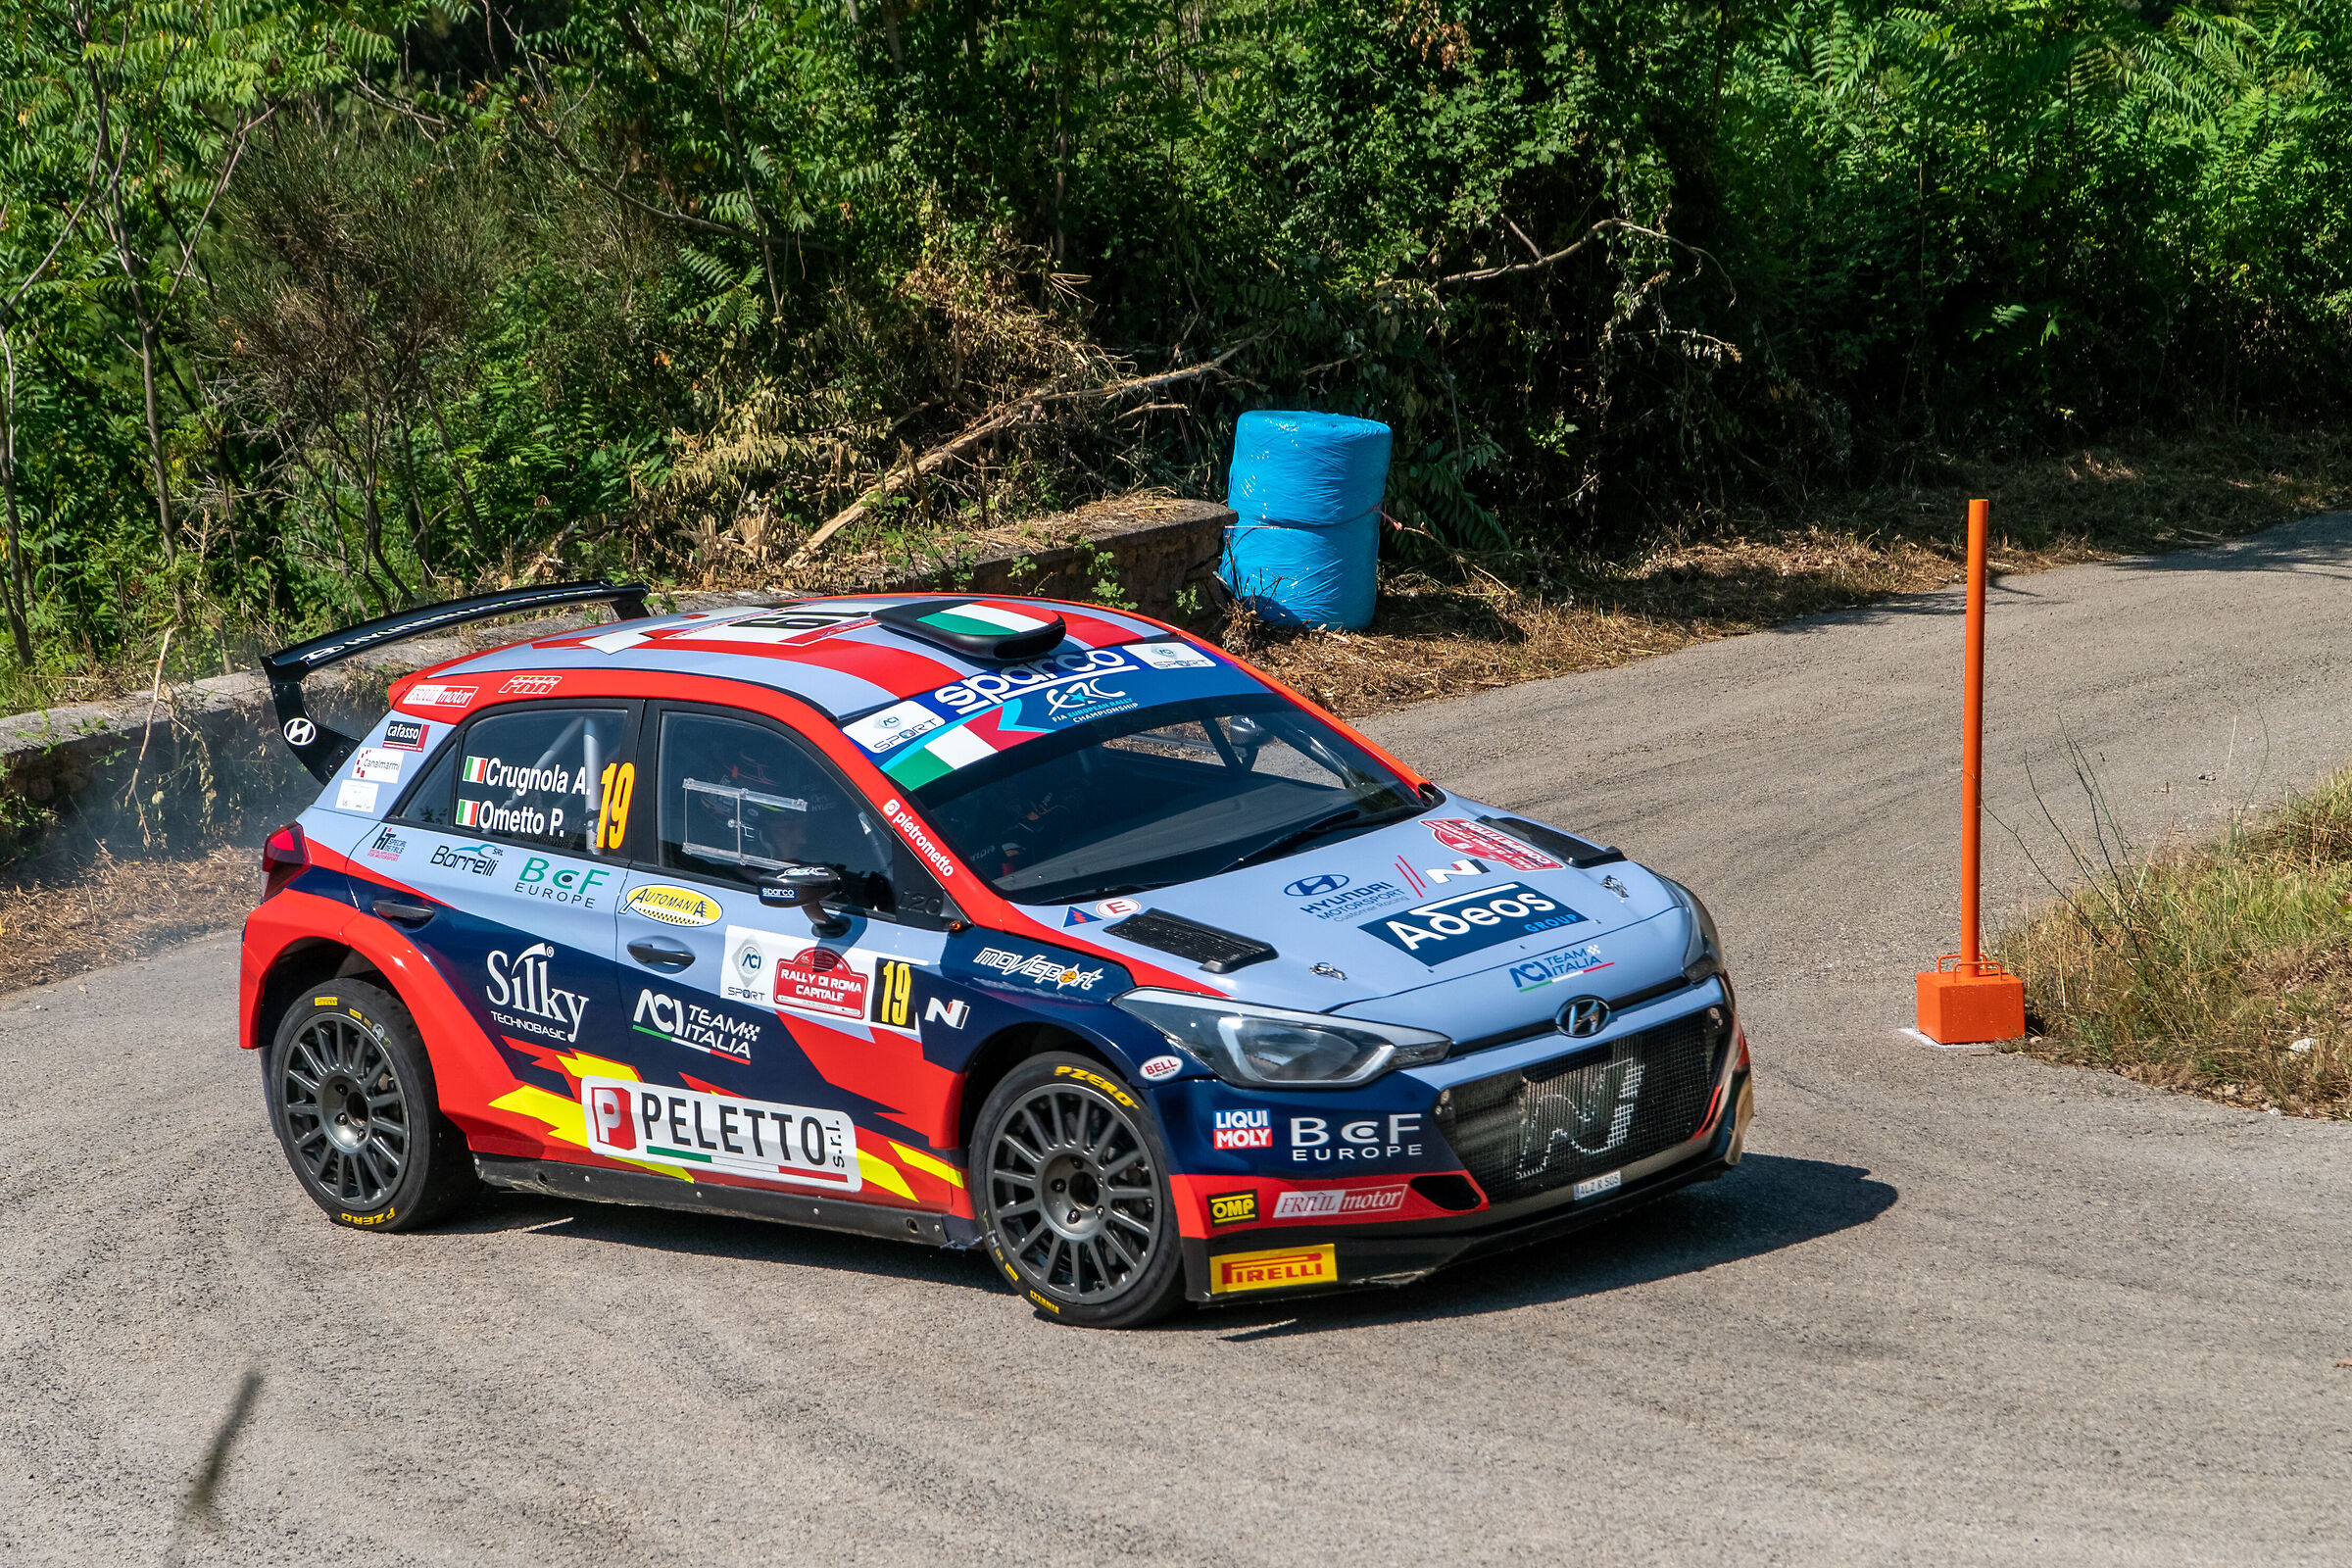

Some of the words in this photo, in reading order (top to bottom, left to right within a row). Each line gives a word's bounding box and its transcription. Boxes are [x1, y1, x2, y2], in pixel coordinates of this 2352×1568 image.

[934, 650, 1126, 706] sparco
[437, 689, 473, 705] motor
[1067, 702, 1108, 718] EUROPEAN
[1108, 697, 1134, 708] RALLY
[1072, 702, 1139, 723] CHAMPIONSHIP
[387, 723, 419, 740] cafasso
[874, 718, 937, 751] SPORT
[486, 758, 569, 797] Crugnola
[571, 766, 591, 795] A.
[478, 800, 545, 834] Ometto
[549, 808, 564, 837] P.
[596, 761, 636, 850] 19
[492, 847, 504, 856] SRL
[892, 811, 954, 877] pietrometto
[514, 882, 596, 908] EUROPE
[761, 887, 795, 898] sparco
[1299, 881, 1395, 913] HYUNDAI
[1316, 888, 1407, 920] MOTORSPORT
[1524, 913, 1578, 932] GROUP
[1544, 948, 1588, 965] TEAM
[1551, 956, 1602, 976] ITALIA
[486, 943, 590, 1043] Silky
[728, 986, 765, 1002] SPORT
[780, 968, 816, 984] RALLY
[818, 975, 829, 987] DI
[830, 977, 862, 994] ROMA
[795, 984, 845, 1003] CAPITALE
[881, 959, 912, 1026] 19
[490, 1010, 566, 1041] TECHNOBASIC
[688, 1004, 746, 1037] TEAM
[684, 1023, 752, 1059] ITALIA
[1145, 1058, 1177, 1075] BELL
[641, 1092, 826, 1166] PELETTO
[1216, 1110, 1268, 1128] LIQUI
[825, 1119, 846, 1168] s.r.l.
[1216, 1129, 1271, 1148] MOLY
[1293, 1143, 1422, 1161] EUROPE
[1212, 1198, 1254, 1219] OMP
[1342, 1190, 1402, 1211] motor
[1221, 1252, 1323, 1285] PIRELLI
